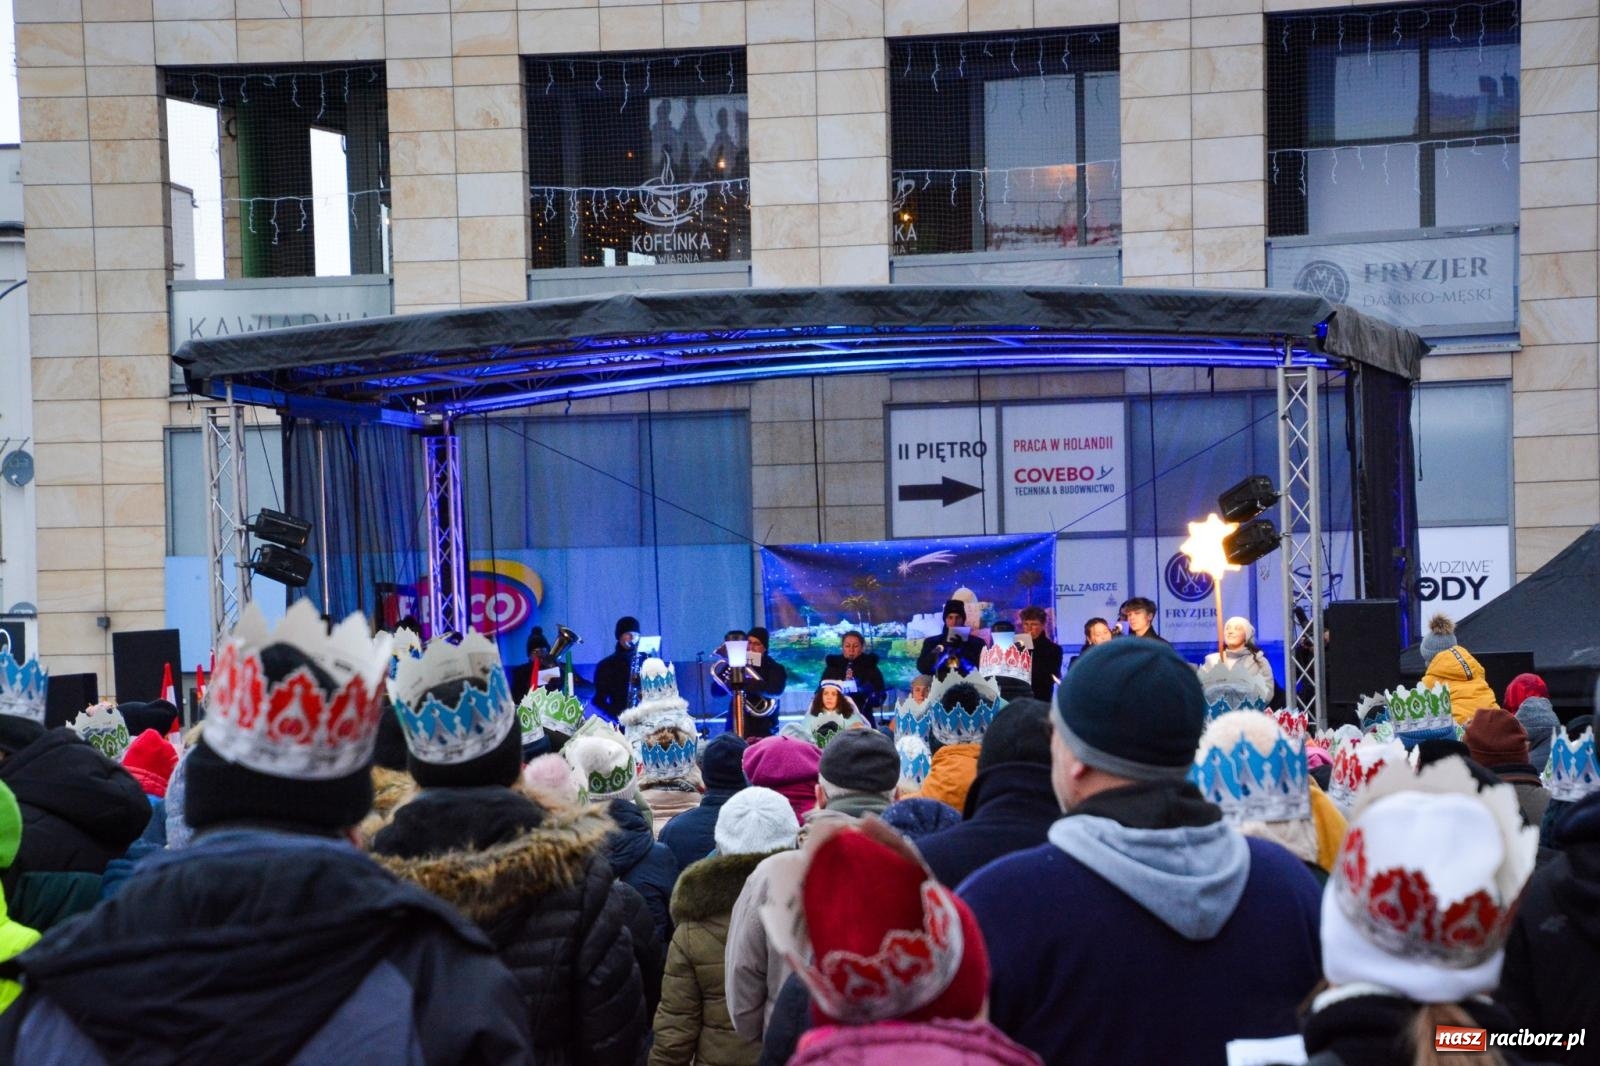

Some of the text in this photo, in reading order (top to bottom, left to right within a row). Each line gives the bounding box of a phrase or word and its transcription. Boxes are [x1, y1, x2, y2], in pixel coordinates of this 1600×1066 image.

[632, 232, 711, 252] KOFEINKA
[1363, 257, 1489, 284] FRYZJER
[1363, 288, 1492, 307] DAMSKO-MĘSKI
[898, 440, 987, 462] II PIĘTRO
[1013, 436, 1113, 452] PRACA W HOLANDII
[1014, 466, 1094, 484] COVEBO
[1015, 484, 1115, 496] TECHNIKA & BUDOWNICTWO
[1420, 560, 1490, 574] WDZIWE
[1078, 582, 1118, 592] ZABRZE
[1165, 608, 1217, 620] FRYZJER
